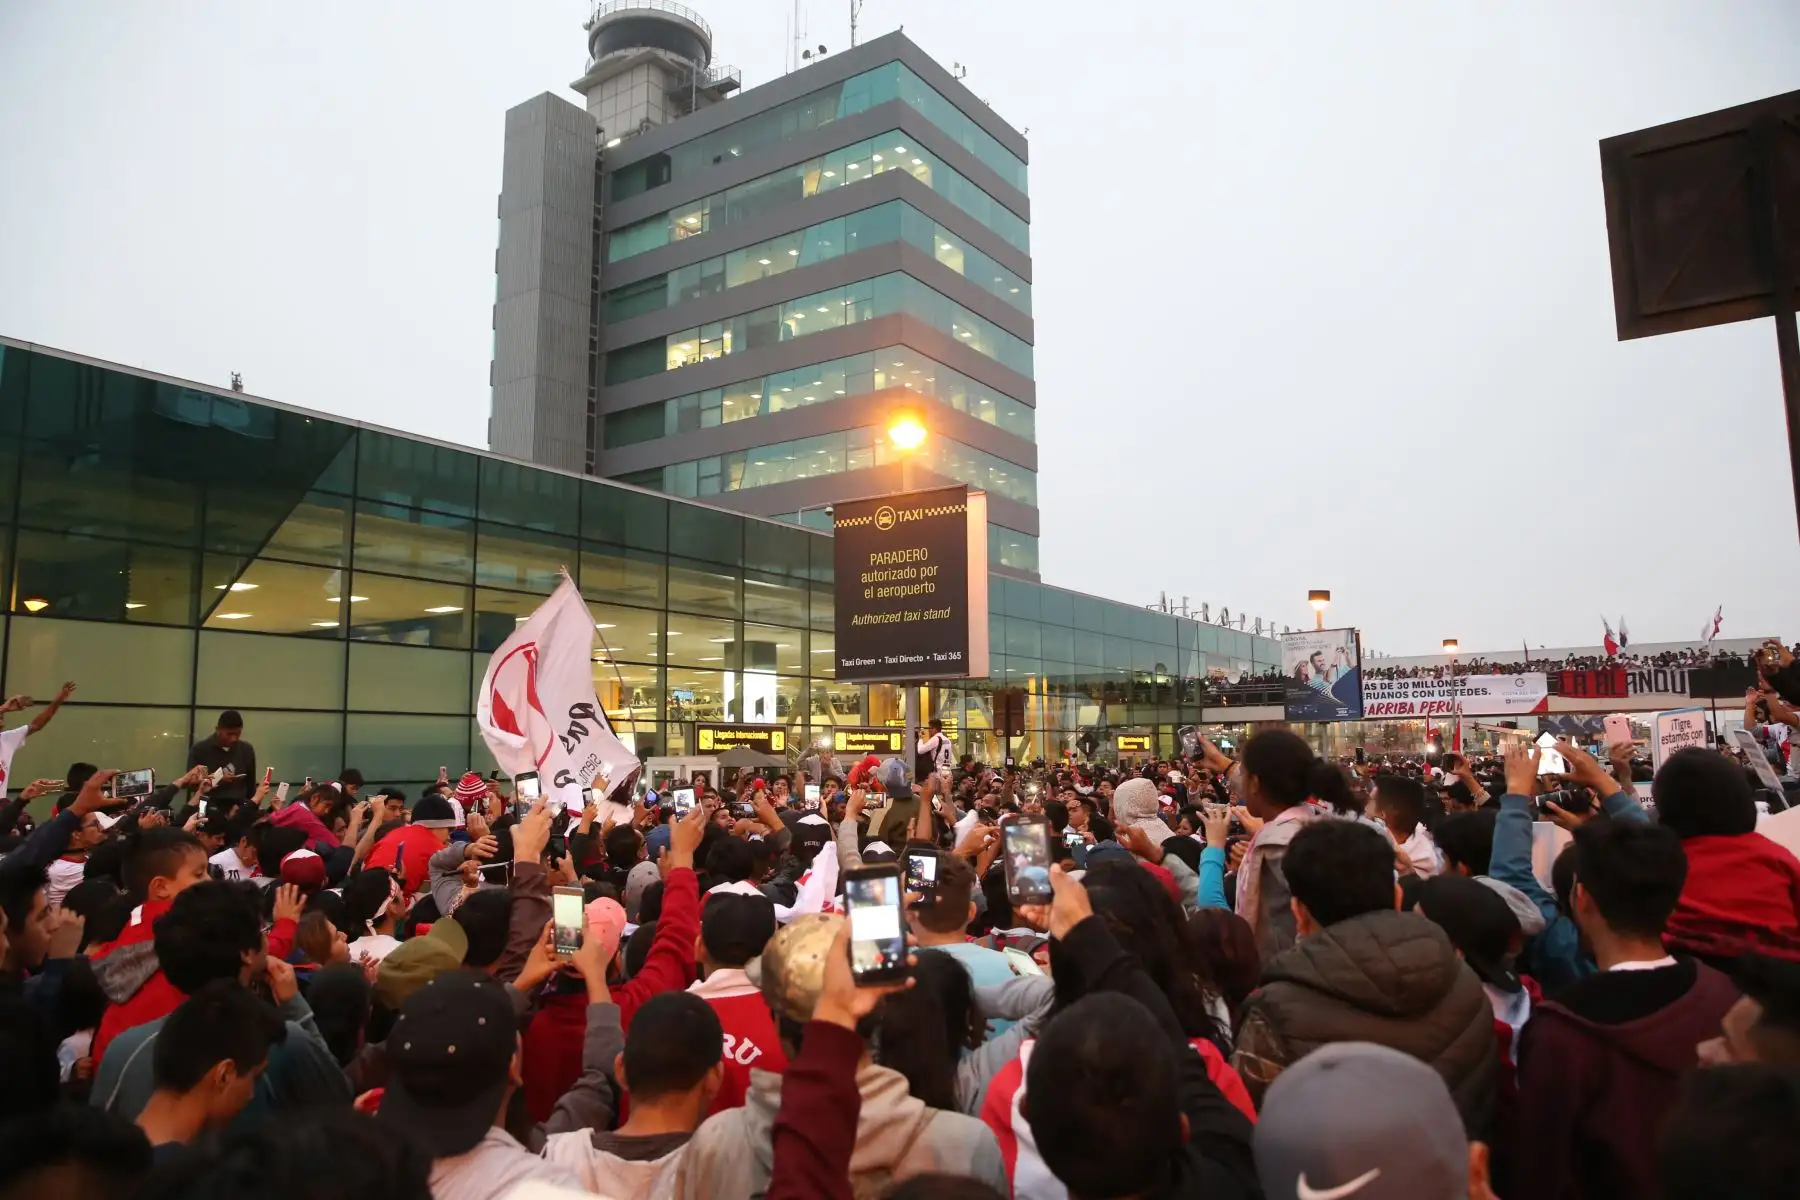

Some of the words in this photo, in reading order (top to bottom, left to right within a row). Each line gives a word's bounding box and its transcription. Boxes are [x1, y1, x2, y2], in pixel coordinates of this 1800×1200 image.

[898, 509, 923, 522] TAXI
[870, 548, 928, 566] PARADERO
[861, 567, 917, 583] autorizado
[920, 565, 939, 579] por
[864, 586, 874, 599] el
[877, 581, 936, 598] aeropuerto
[851, 611, 901, 626] Authorized
[903, 609, 921, 622] taxi
[923, 606, 951, 620] stand
[841, 659, 855, 667] Taxi
[855, 658, 876, 666] Green
[884, 656, 898, 664] Taxi
[899, 655, 924, 663] Directo
[933, 652, 947, 661] Taxi
[948, 651, 962, 660] 365
[1380, 681, 1394, 690] DE
[1397, 680, 1409, 690] 30
[1412, 678, 1467, 689] MILLONES
[1412, 689, 1435, 699] CON
[1438, 687, 1492, 698] USTEDES.
[1661, 731, 1690, 745] estamos
[1691, 730, 1704, 739] con
